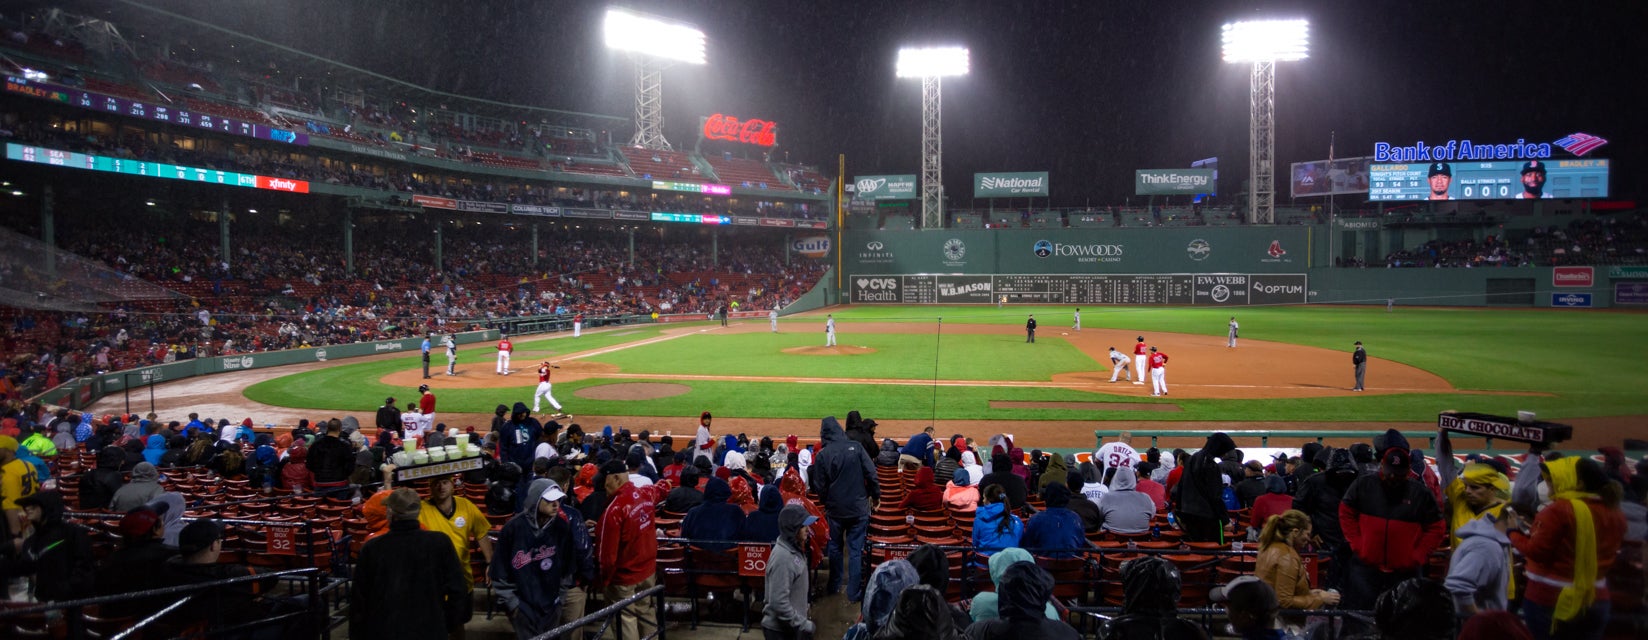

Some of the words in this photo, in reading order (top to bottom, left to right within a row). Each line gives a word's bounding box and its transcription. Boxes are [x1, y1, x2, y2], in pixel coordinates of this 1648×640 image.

[7, 83, 46, 96] BRADLEY
[704, 113, 776, 146] Coca-Cola
[1374, 141, 1431, 162] Bank
[1432, 139, 1456, 160] of
[1457, 138, 1551, 160] America
[269, 179, 296, 192] xfinity
[995, 177, 1042, 188] National
[1464, 186, 1472, 197] 0
[1482, 186, 1490, 197] 0
[1500, 186, 1508, 196] 0
[793, 240, 828, 250] Gulf
[1055, 243, 1123, 256] FOXWOODS
[870, 279, 896, 289] CVS
[1265, 285, 1302, 294] OPTUM
[858, 290, 896, 301] Health
[404, 422, 417, 431] 50
[1442, 416, 1466, 429] HOT
[1468, 419, 1542, 441] CHOCOLATE
[1113, 446, 1132, 456] ORTIZ
[1109, 454, 1130, 468] 34
[404, 460, 477, 478] LEMONADE
[272, 539, 291, 550] 32
[512, 550, 532, 570] Red
[533, 545, 556, 561] Sox
[743, 559, 766, 571] 30
